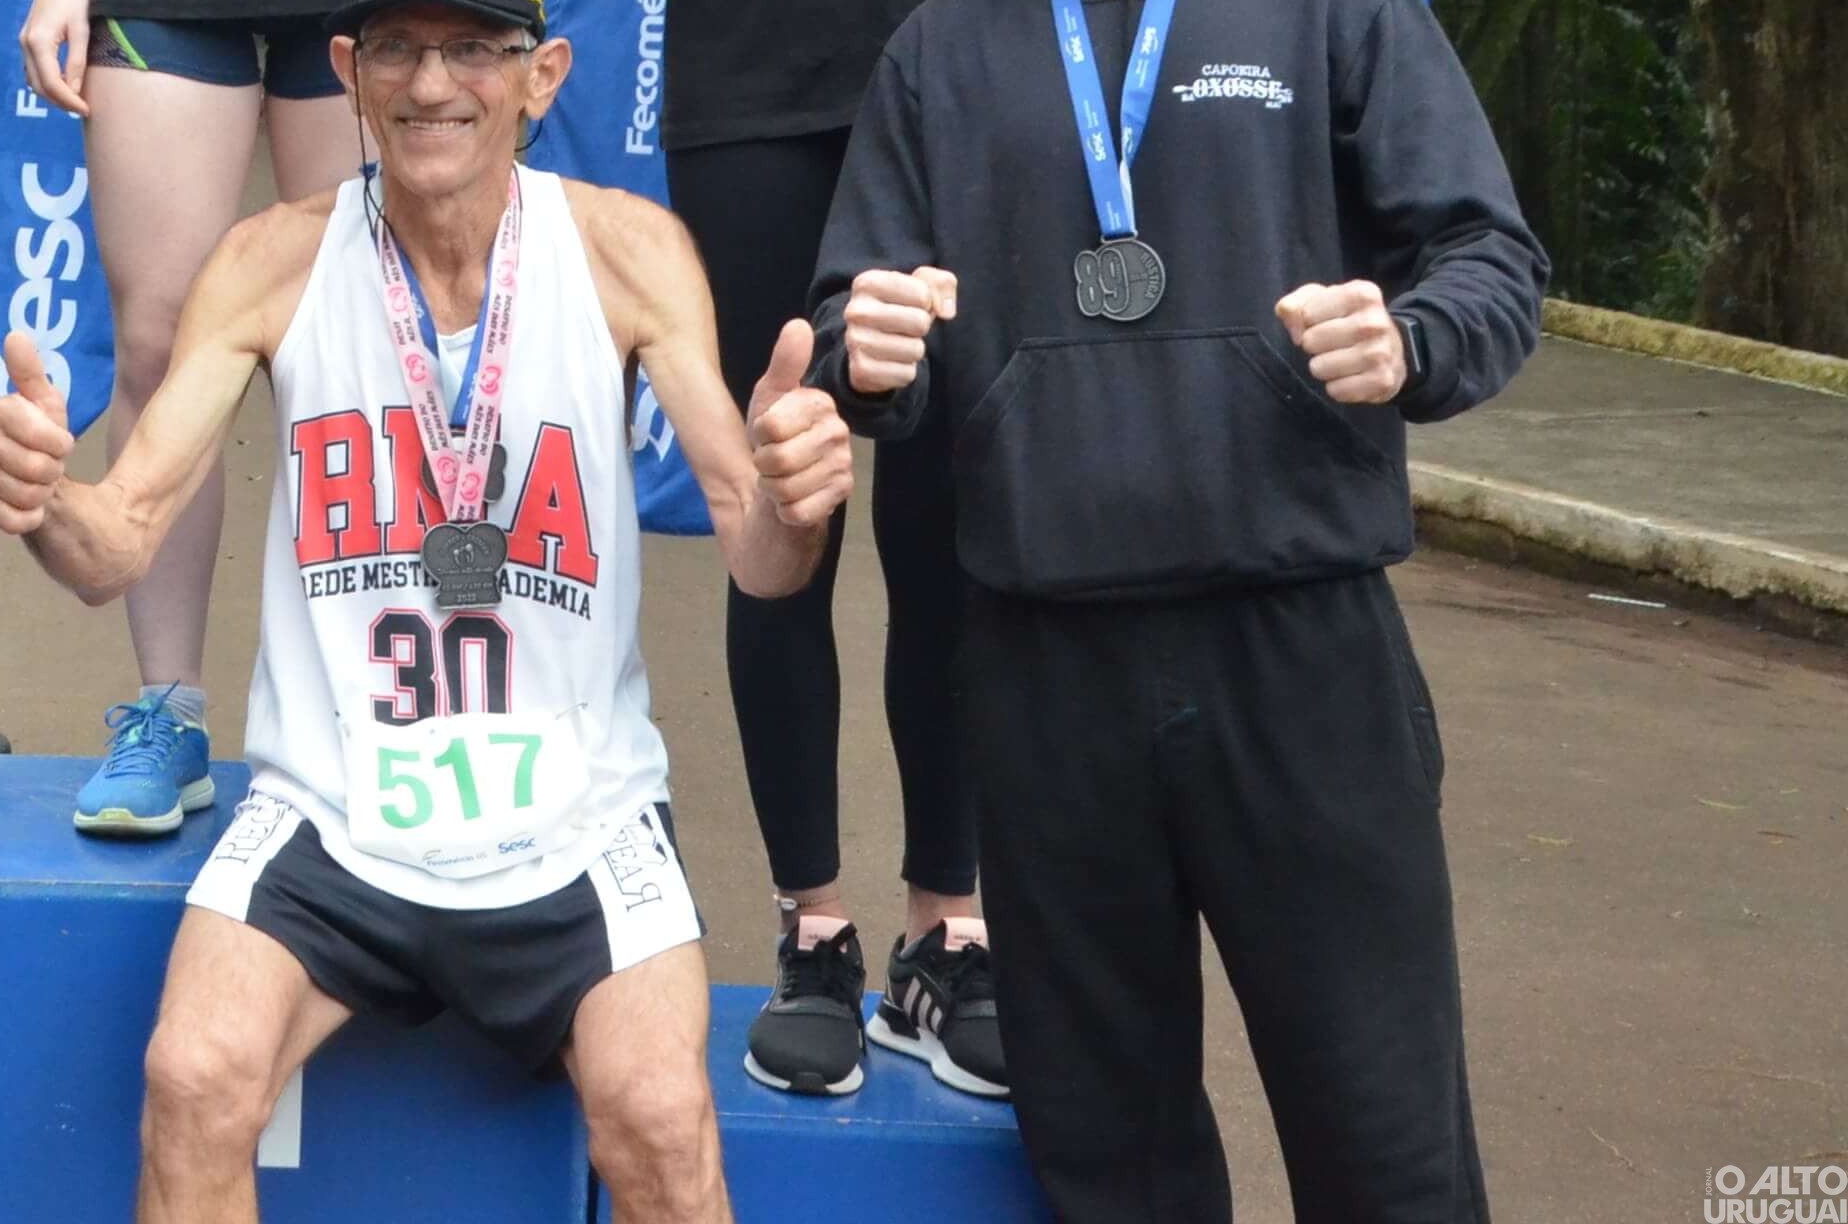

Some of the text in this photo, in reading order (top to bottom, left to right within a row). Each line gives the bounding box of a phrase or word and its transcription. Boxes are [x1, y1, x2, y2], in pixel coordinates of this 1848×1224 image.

[1201, 64, 1271, 78] CAPOEIRA
[302, 566, 357, 601] EDE
[368, 607, 513, 726] 30
[377, 733, 543, 829] 517
